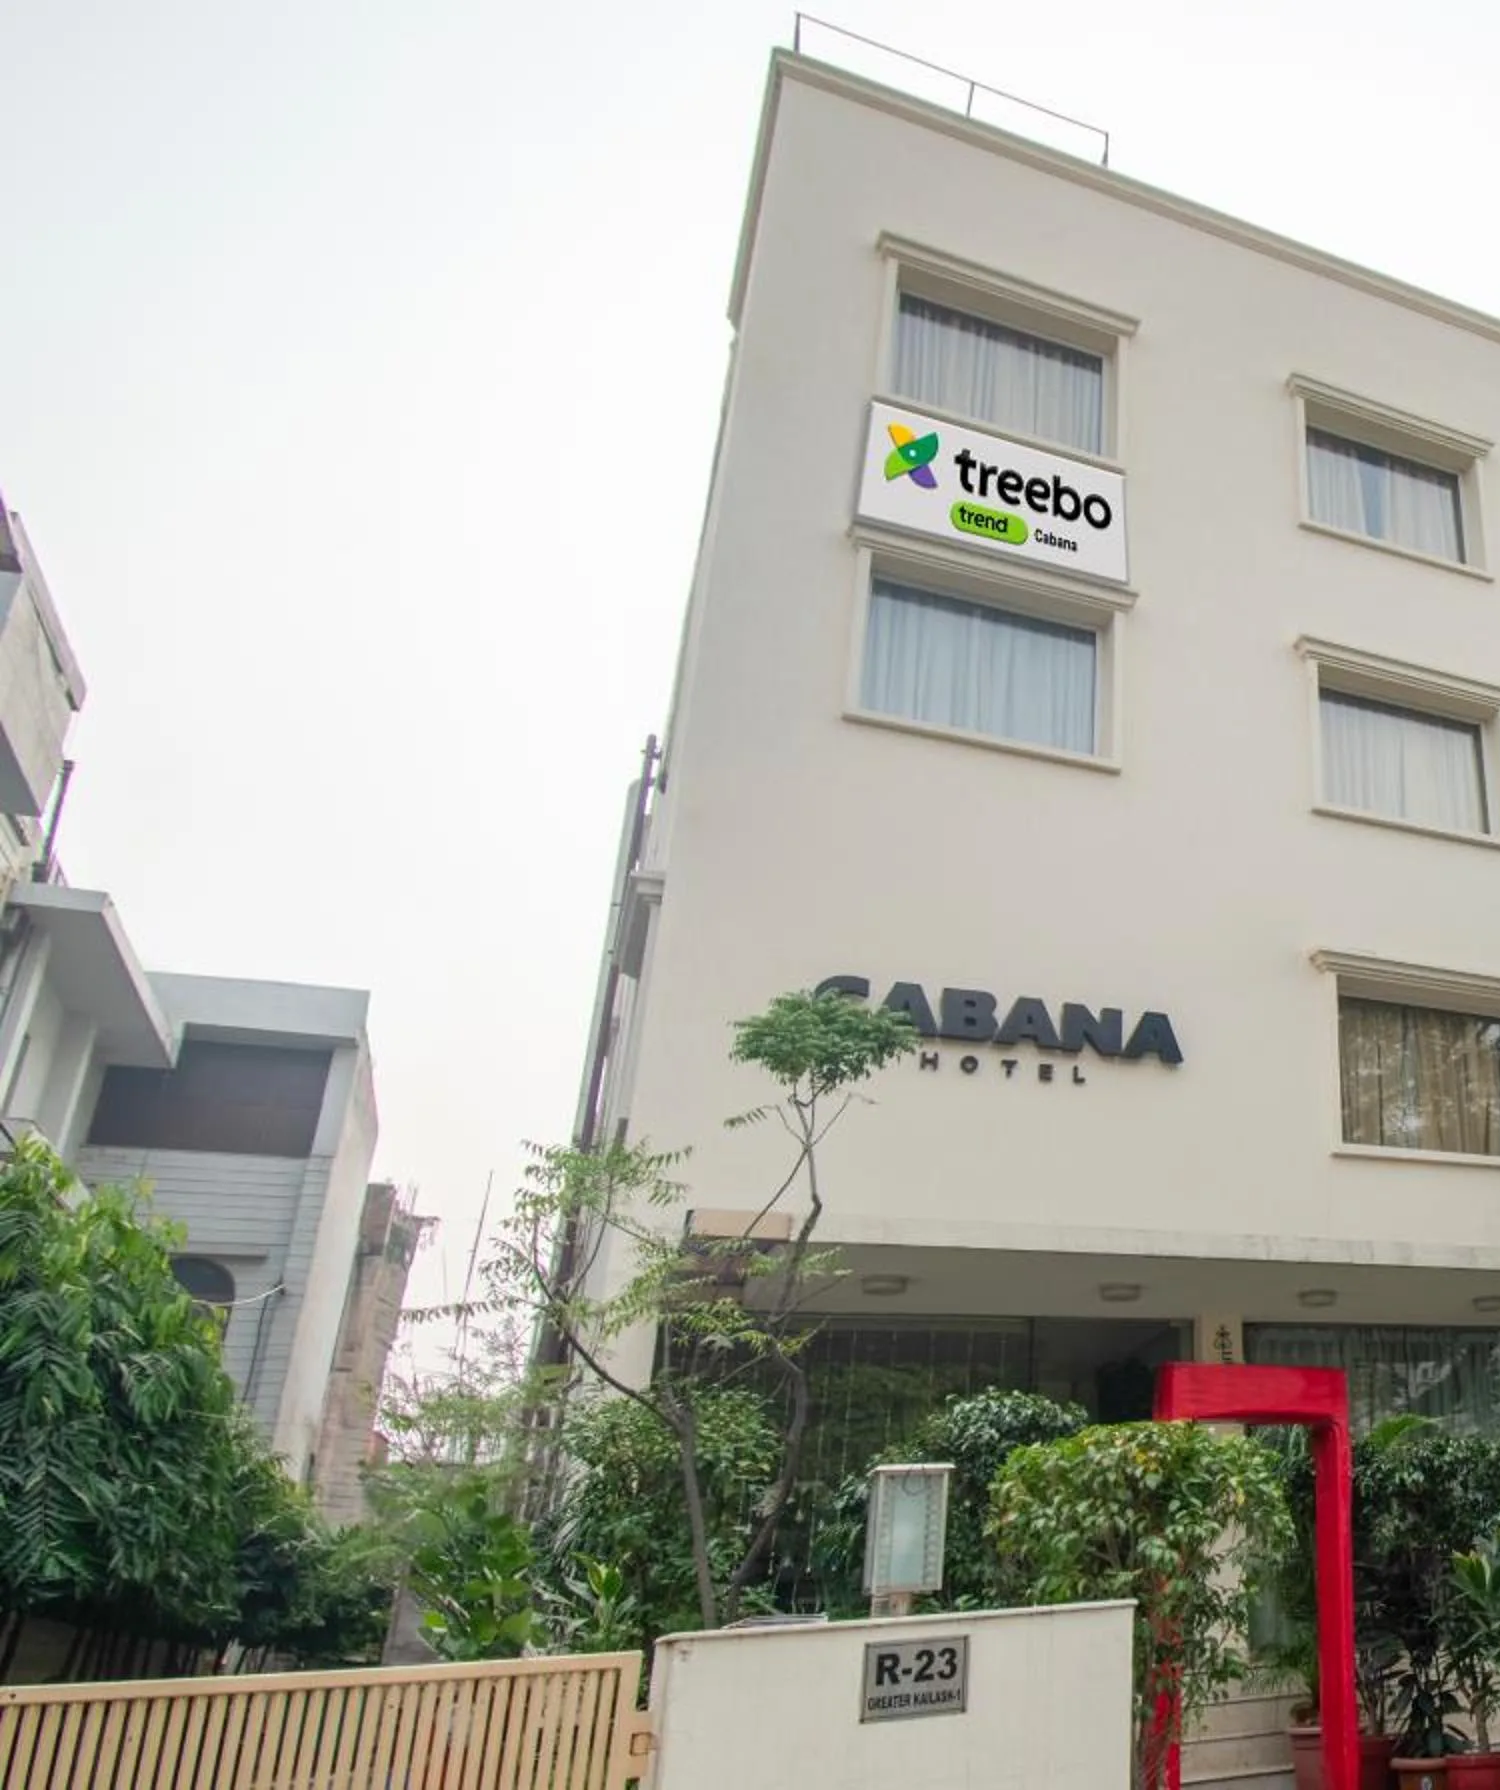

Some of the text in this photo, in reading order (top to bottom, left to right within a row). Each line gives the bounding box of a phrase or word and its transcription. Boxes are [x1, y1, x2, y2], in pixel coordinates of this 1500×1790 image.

[954, 449, 1112, 529] treebo
[959, 505, 1008, 533] trend
[1034, 529, 1077, 551] Cabana
[919, 1052, 1085, 1084] HOTEL
[876, 1648, 957, 1686] R-23
[868, 1693, 910, 1710] GREATER
